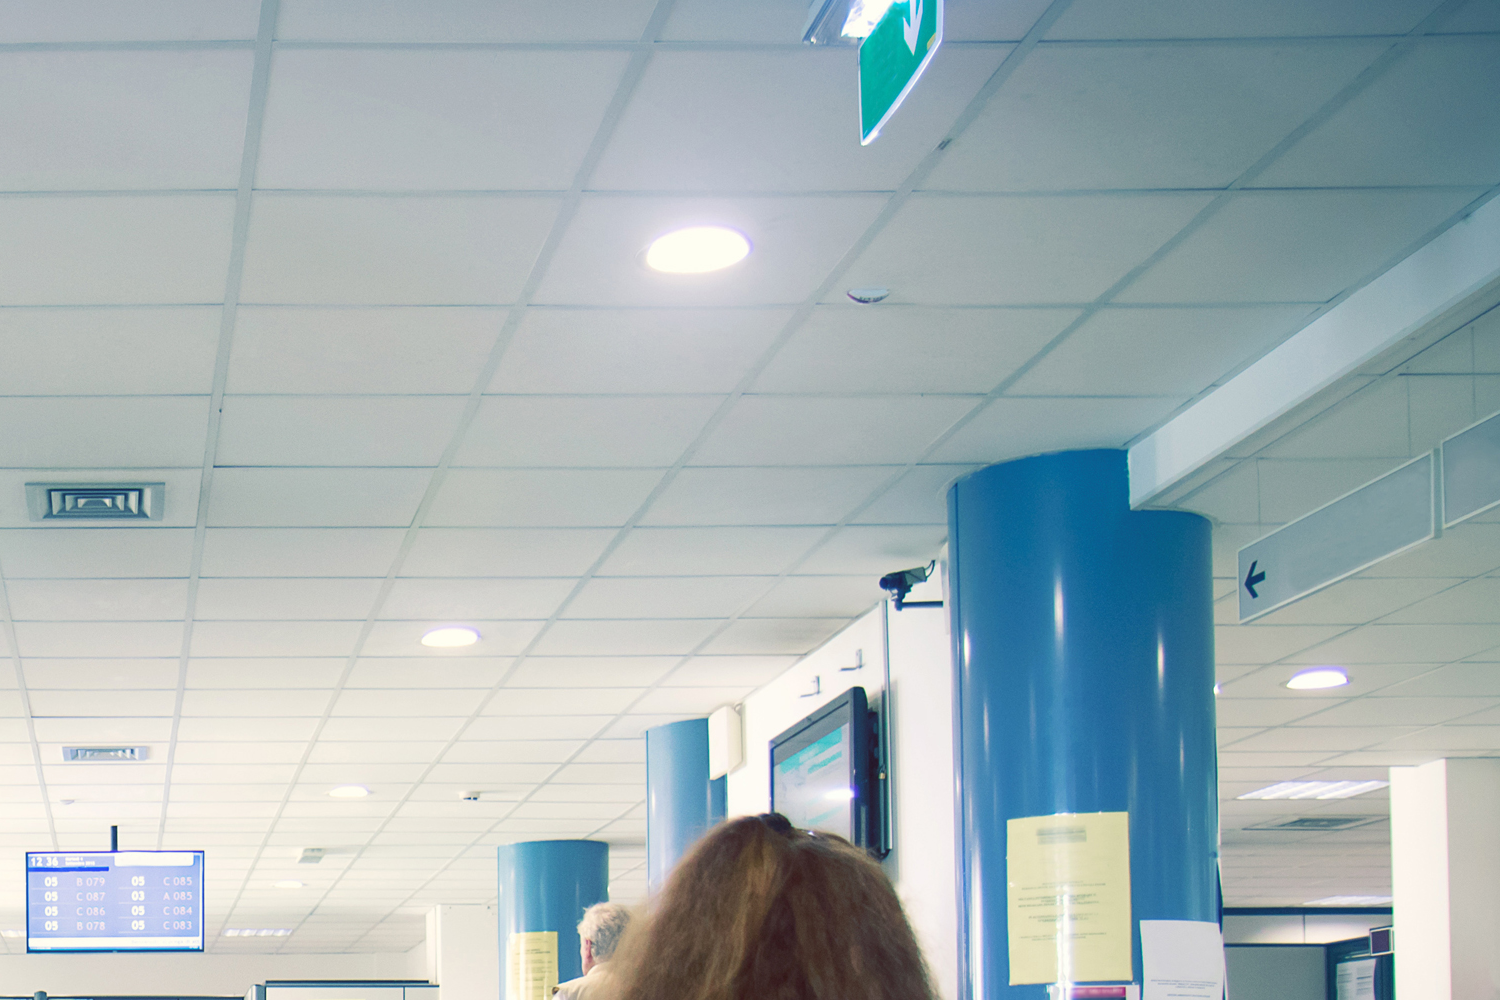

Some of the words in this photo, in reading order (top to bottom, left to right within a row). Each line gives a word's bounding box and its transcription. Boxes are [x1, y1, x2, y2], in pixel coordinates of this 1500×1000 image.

[45, 876, 58, 887] 05
[76, 877, 83, 887] B
[86, 877, 106, 887] 079
[132, 876, 145, 886] 05
[163, 877, 171, 886] C
[173, 877, 193, 886] 085
[45, 891, 58, 902] 05
[76, 892, 83, 902] C
[86, 892, 106, 902] 087
[132, 891, 145, 901] 03
[163, 891, 171, 901] A
[173, 891, 193, 901] 085
[45, 906, 58, 917] 05
[76, 907, 83, 916] C
[86, 907, 106, 916] 086
[132, 905, 145, 916] 05
[163, 906, 171, 916] C
[173, 906, 193, 916] 084
[45, 920, 58, 931] 05
[76, 921, 83, 931] B
[86, 921, 106, 931] 078
[132, 920, 145, 931] 05
[163, 921, 171, 930] C
[173, 921, 193, 930] 083
